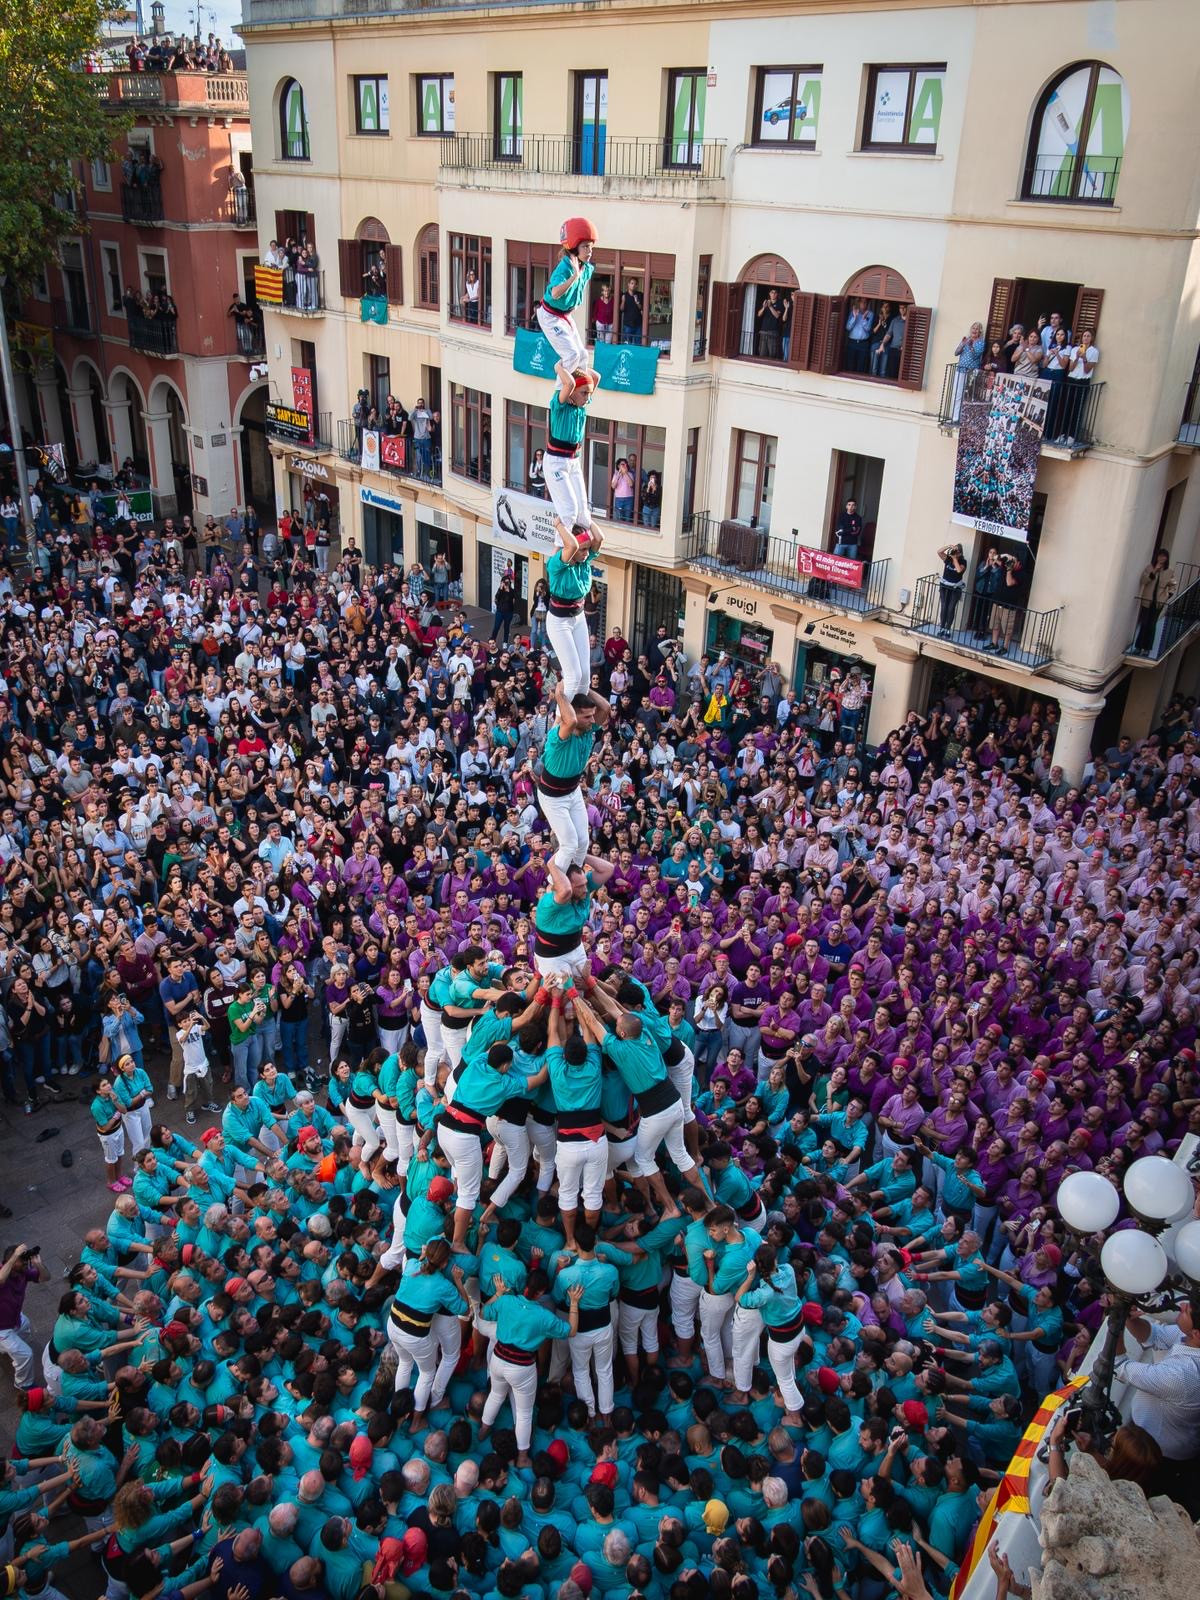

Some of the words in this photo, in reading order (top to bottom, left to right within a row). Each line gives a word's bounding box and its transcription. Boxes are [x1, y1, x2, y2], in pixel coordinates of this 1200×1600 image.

[361, 84, 377, 129] A
[423, 84, 440, 131] A
[795, 80, 821, 140] A
[909, 79, 943, 143] A
[532, 514, 554, 527] CASTELL
